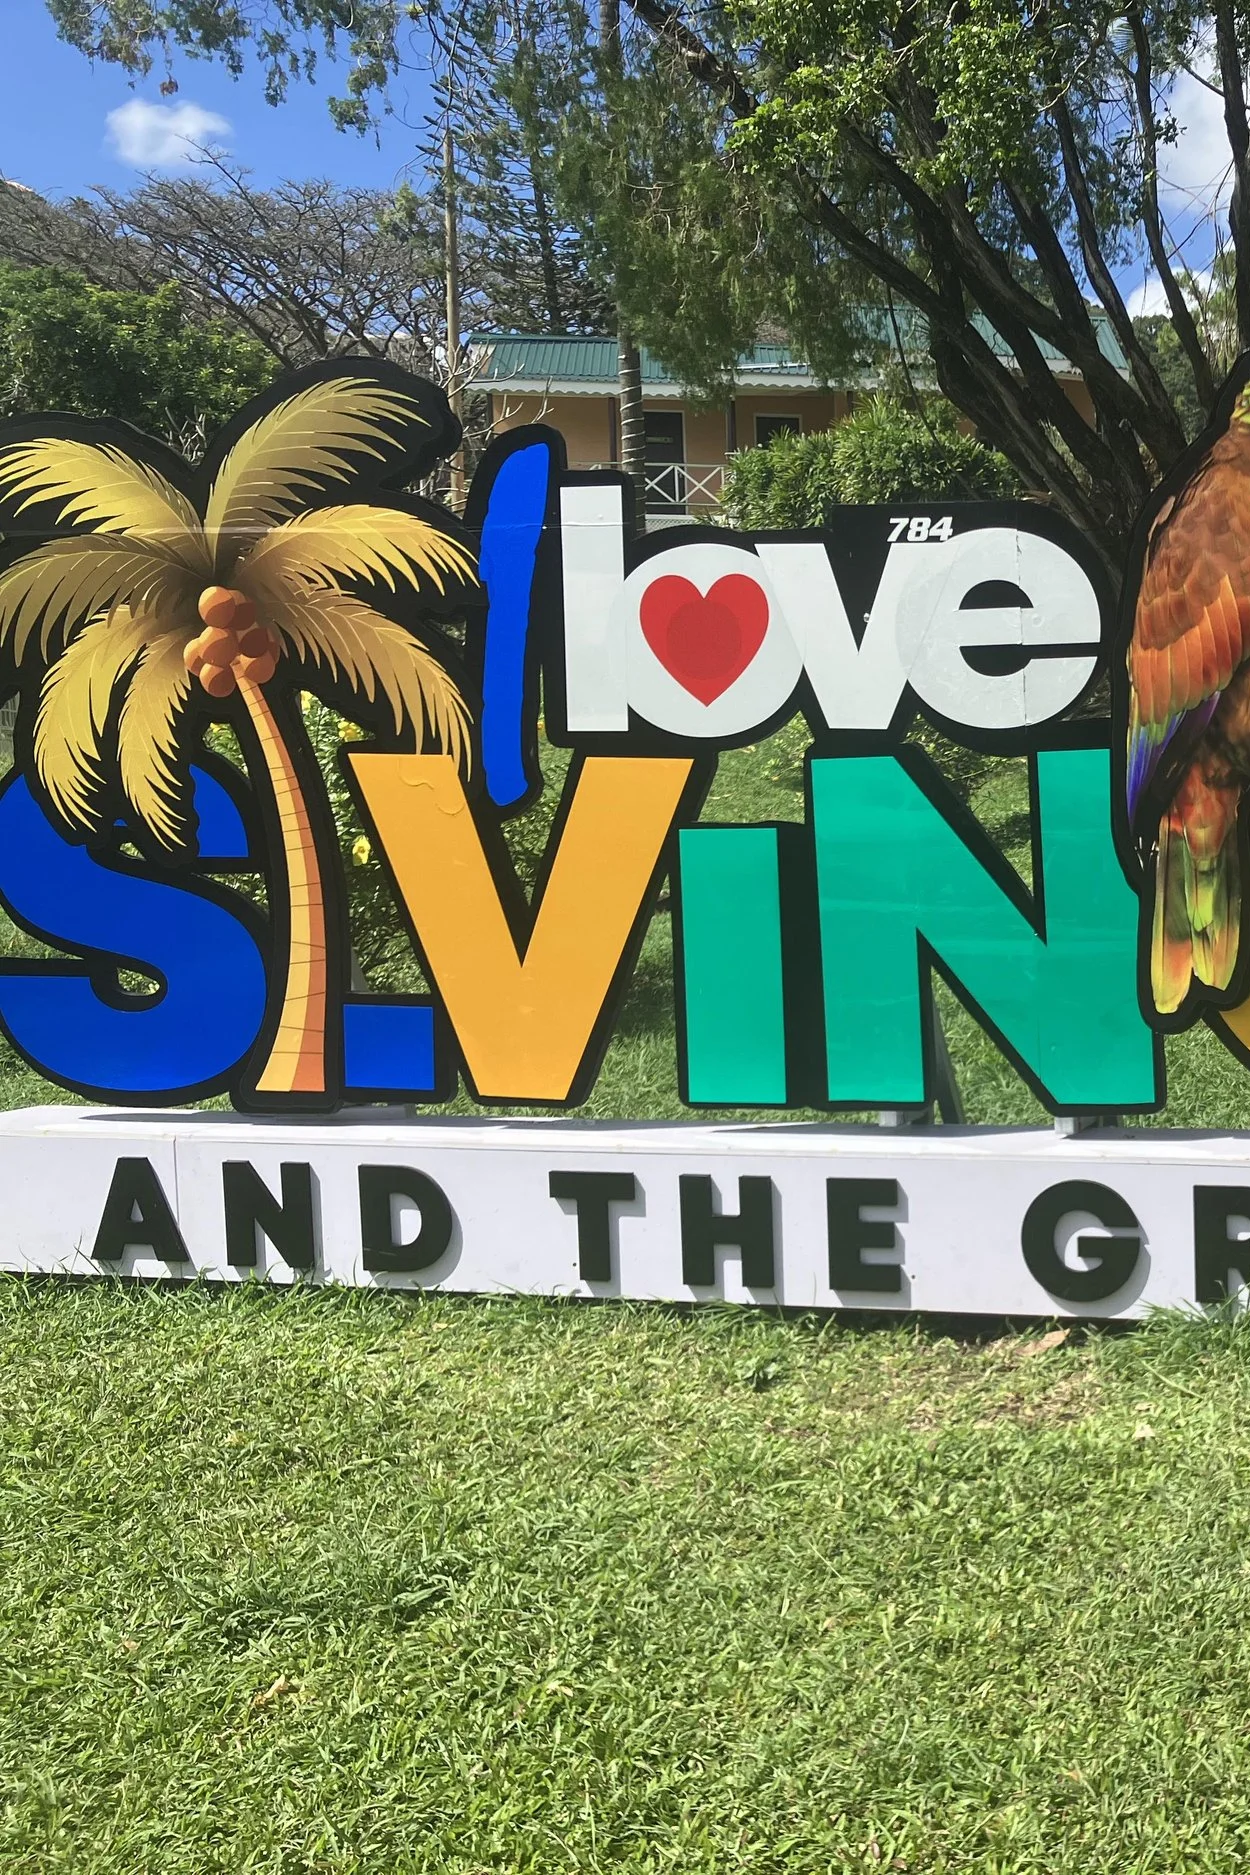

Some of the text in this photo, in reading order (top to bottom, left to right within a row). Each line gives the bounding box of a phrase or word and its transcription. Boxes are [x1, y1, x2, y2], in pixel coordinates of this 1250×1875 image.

[887, 516, 953, 542] 784
[560, 485, 1101, 737] love
[92, 1157, 452, 1272] AND
[549, 1170, 902, 1292] THE
